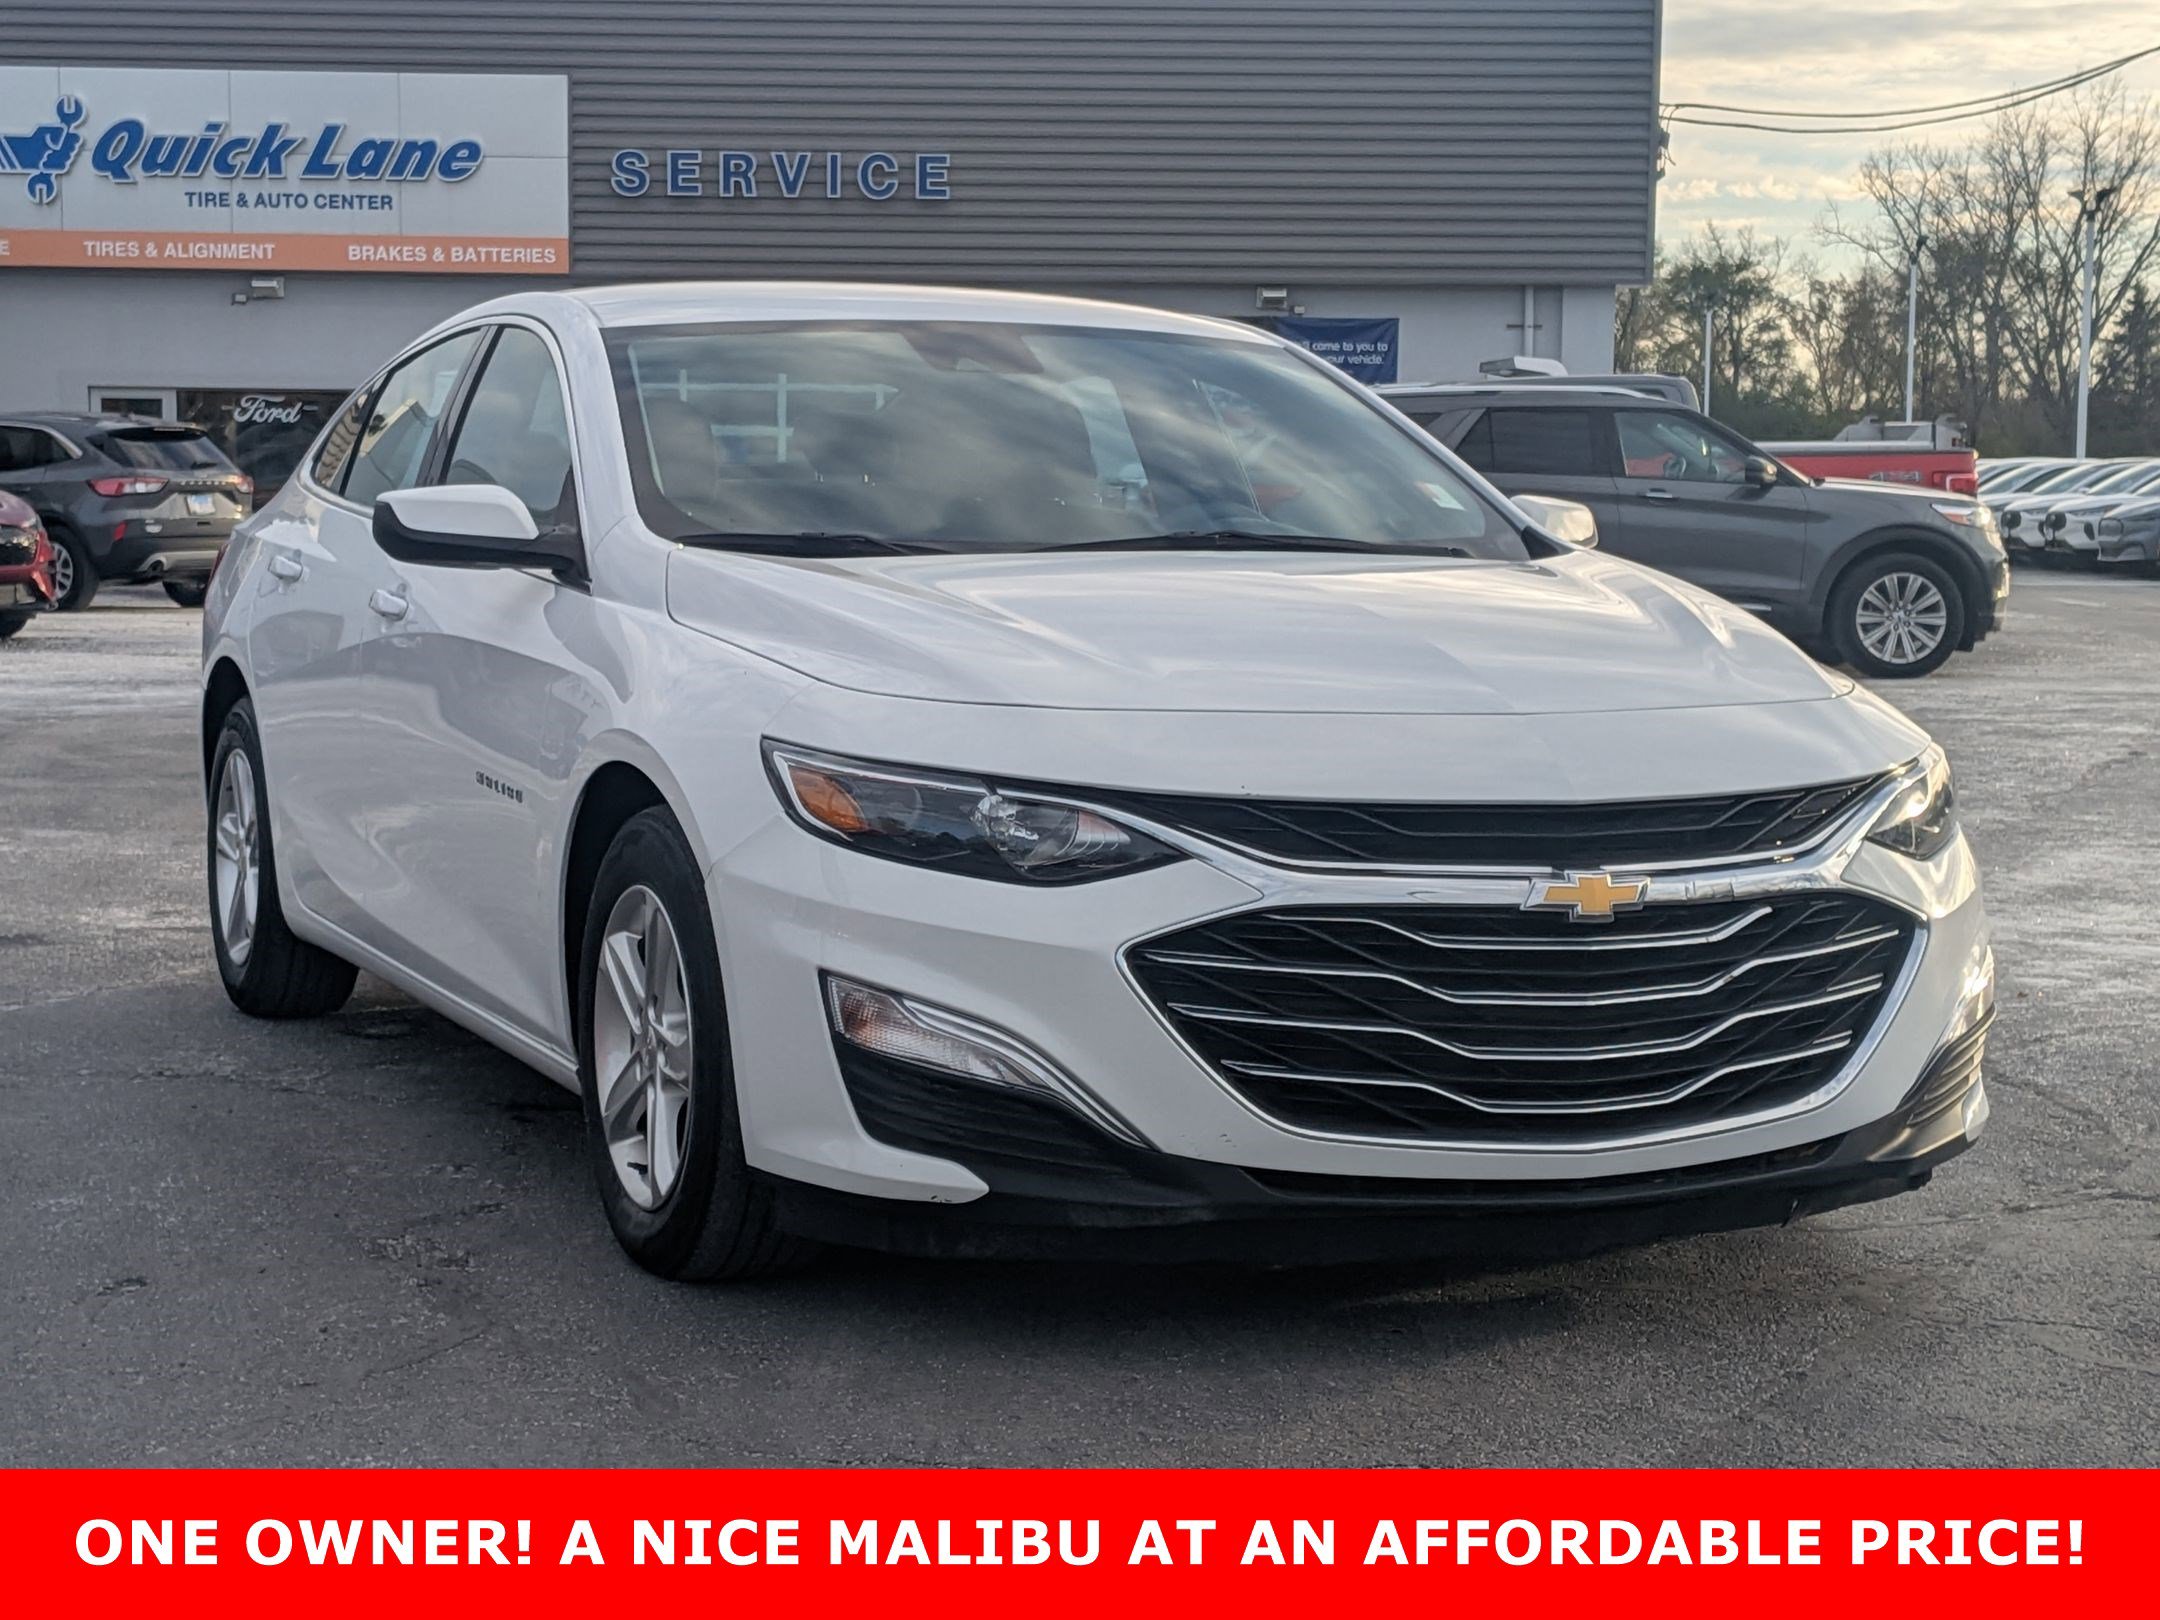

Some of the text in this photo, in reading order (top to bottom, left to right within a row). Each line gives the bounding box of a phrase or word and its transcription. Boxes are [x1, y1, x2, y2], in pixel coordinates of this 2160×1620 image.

[91, 118, 484, 184] Quick Lane
[610, 149, 951, 200] SERVICE
[185, 191, 393, 210] TIRE & AUTO CENTER
[84, 240, 275, 260] TIRES & ALIGNMENT
[348, 245, 556, 263] BRAKES & BATTERIES
[1312, 342, 1340, 351] come
[1343, 342, 1354, 351] to
[1356, 343, 1374, 353] you
[1377, 342, 1388, 351] to
[233, 394, 303, 423] Ford
